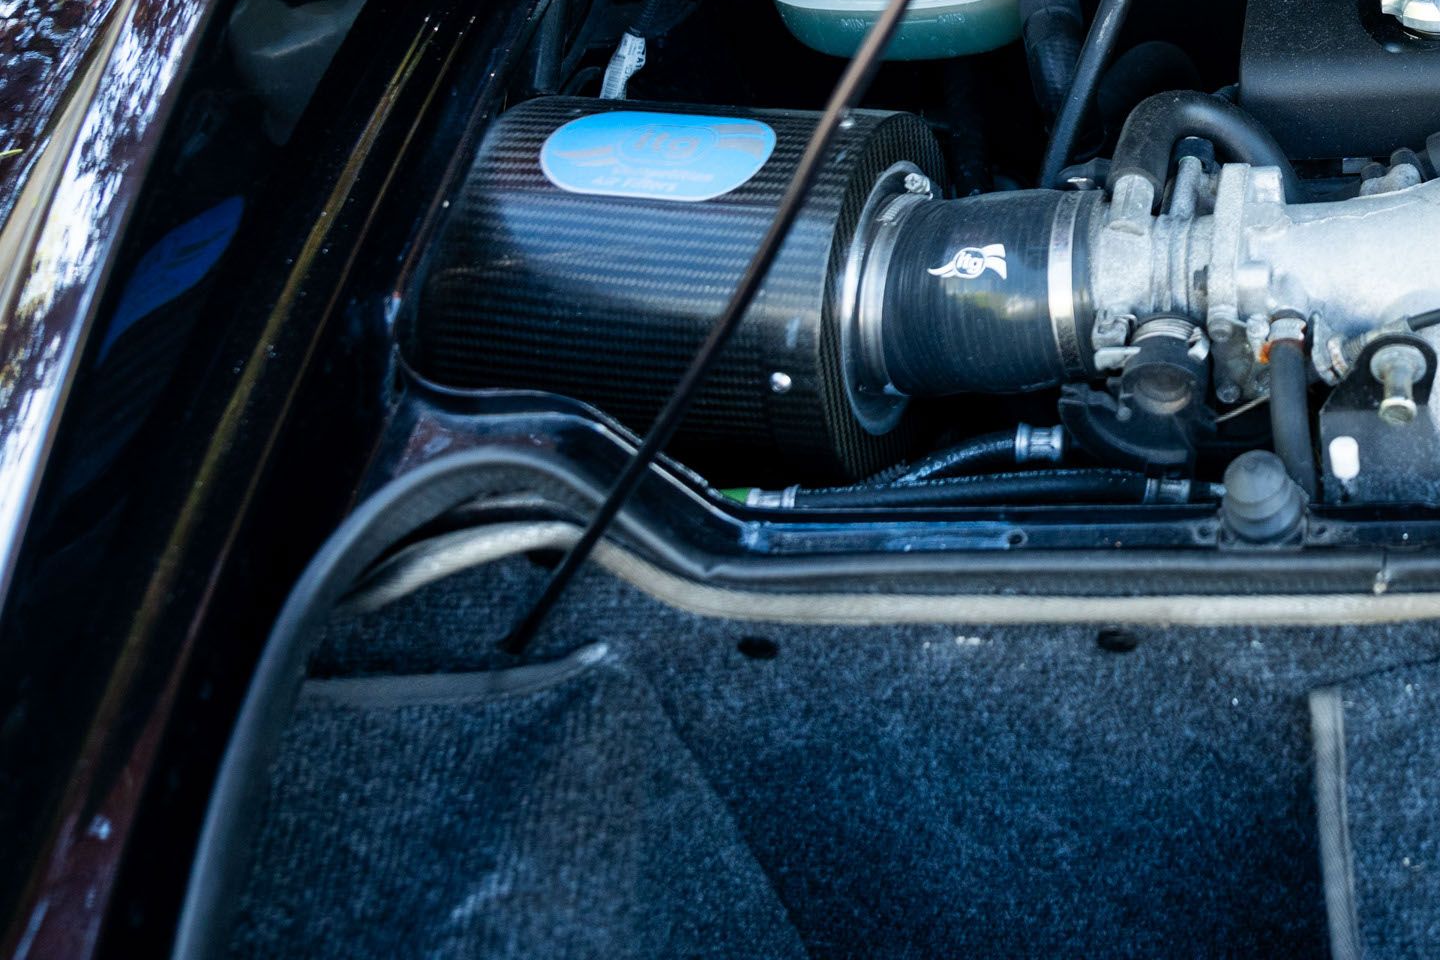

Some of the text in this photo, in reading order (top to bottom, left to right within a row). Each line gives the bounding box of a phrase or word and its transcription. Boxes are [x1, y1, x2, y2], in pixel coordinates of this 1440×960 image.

[840, 18, 866, 29] MIN
[634, 128, 699, 159] itg
[956, 251, 984, 274] itg
